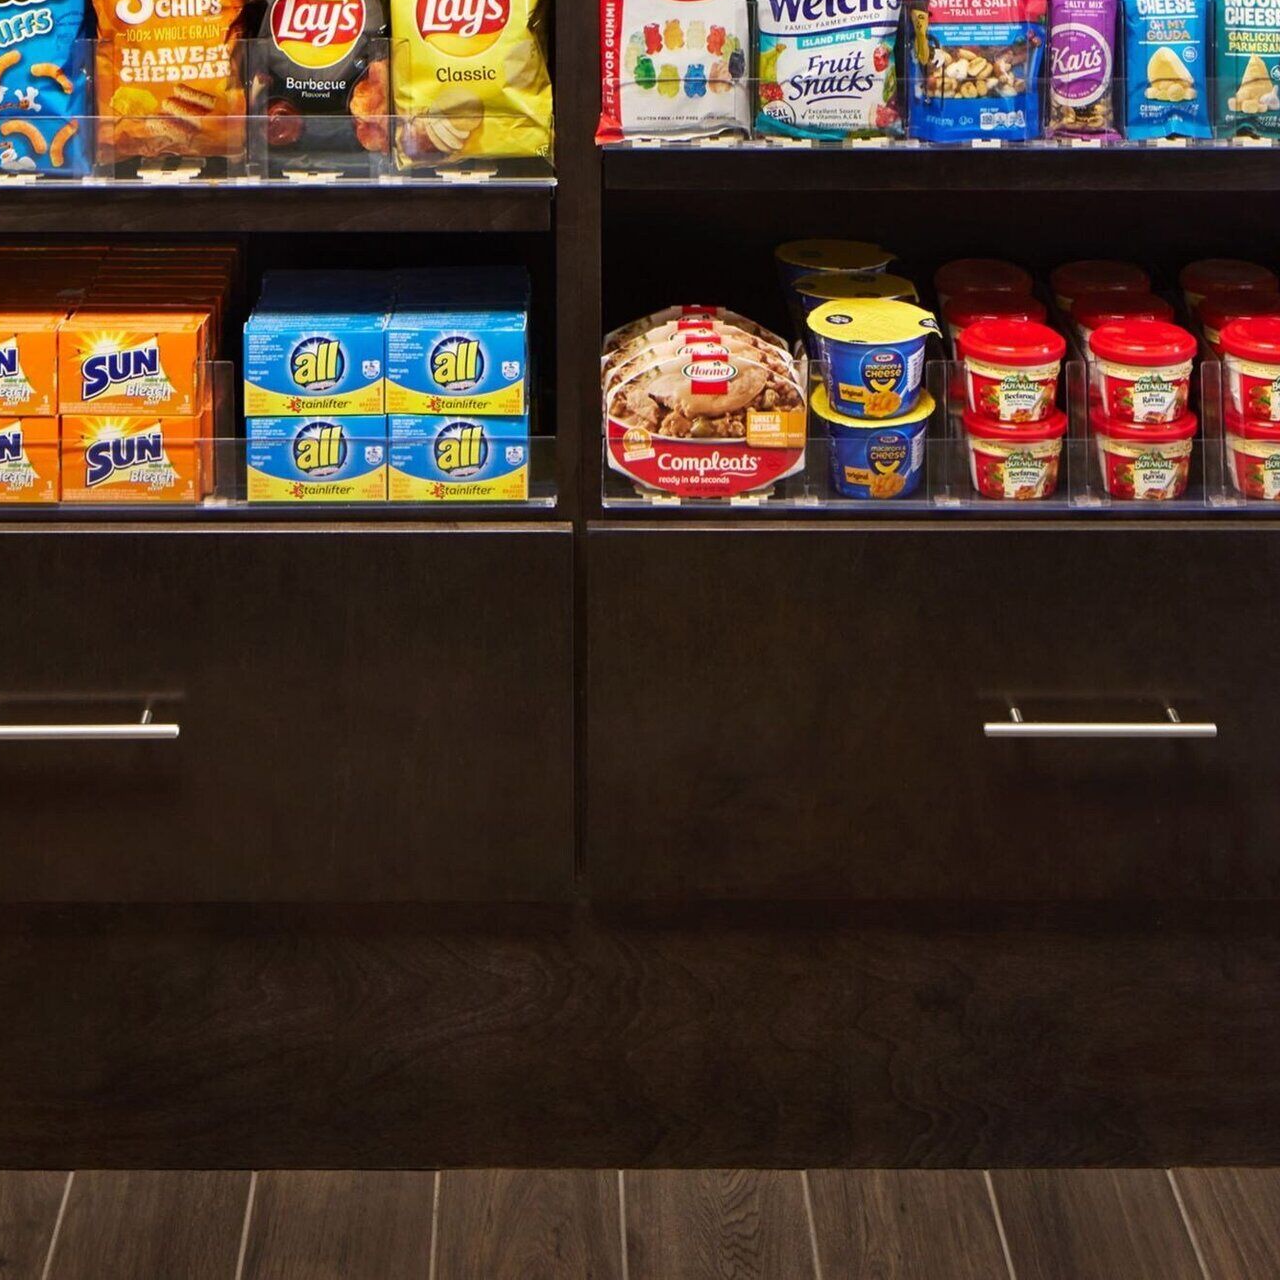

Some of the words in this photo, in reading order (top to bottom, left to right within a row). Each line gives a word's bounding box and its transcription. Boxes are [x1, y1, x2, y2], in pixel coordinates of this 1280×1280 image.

[975, 8, 992, 16] MIX
[126, 28, 151, 41] 100%
[154, 28, 187, 40] WHOLE
[189, 26, 220, 39] GRAIN
[802, 34, 833, 46] ISLAND
[834, 31, 865, 42] FRUITS
[1146, 30, 1190, 41] GOUDA
[121, 44, 230, 67] HARVEST
[808, 52, 864, 72] Fruit
[1051, 46, 1102, 74] Kar's
[120, 61, 231, 82] CHEDDAR
[436, 66, 496, 82] Classic
[286, 77, 346, 90] Barbecue
[789, 73, 875, 101] Snacks
[293, 341, 340, 384] all
[690, 365, 730, 377] Hormel
[658, 451, 757, 476] Compleats
[659, 476, 680, 485] ready
[682, 475, 688, 483] in
[701, 476, 729, 484] seconds
